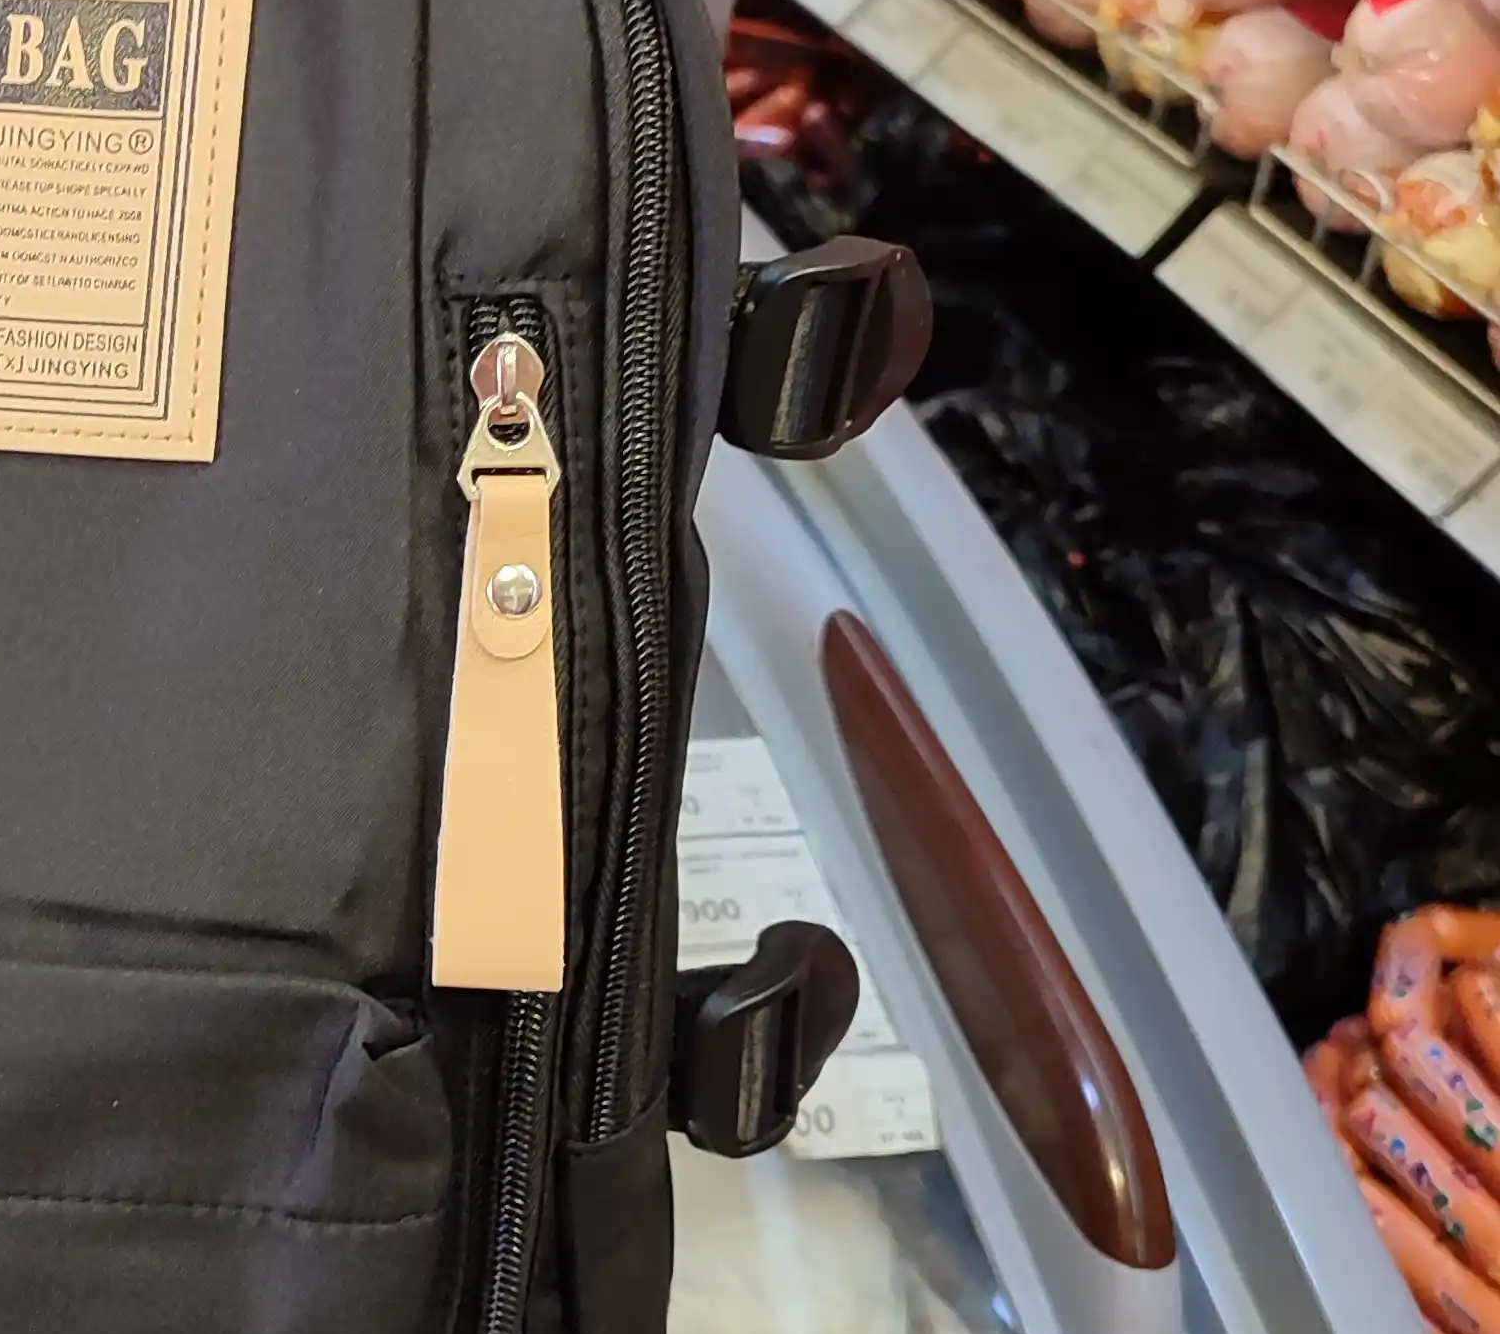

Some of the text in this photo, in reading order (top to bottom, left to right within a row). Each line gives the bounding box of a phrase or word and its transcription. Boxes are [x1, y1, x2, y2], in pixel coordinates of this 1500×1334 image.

[0, 14, 149, 93] BAG
[73, 332, 138, 355] DESIGN
[28, 357, 130, 380] JINGYING
